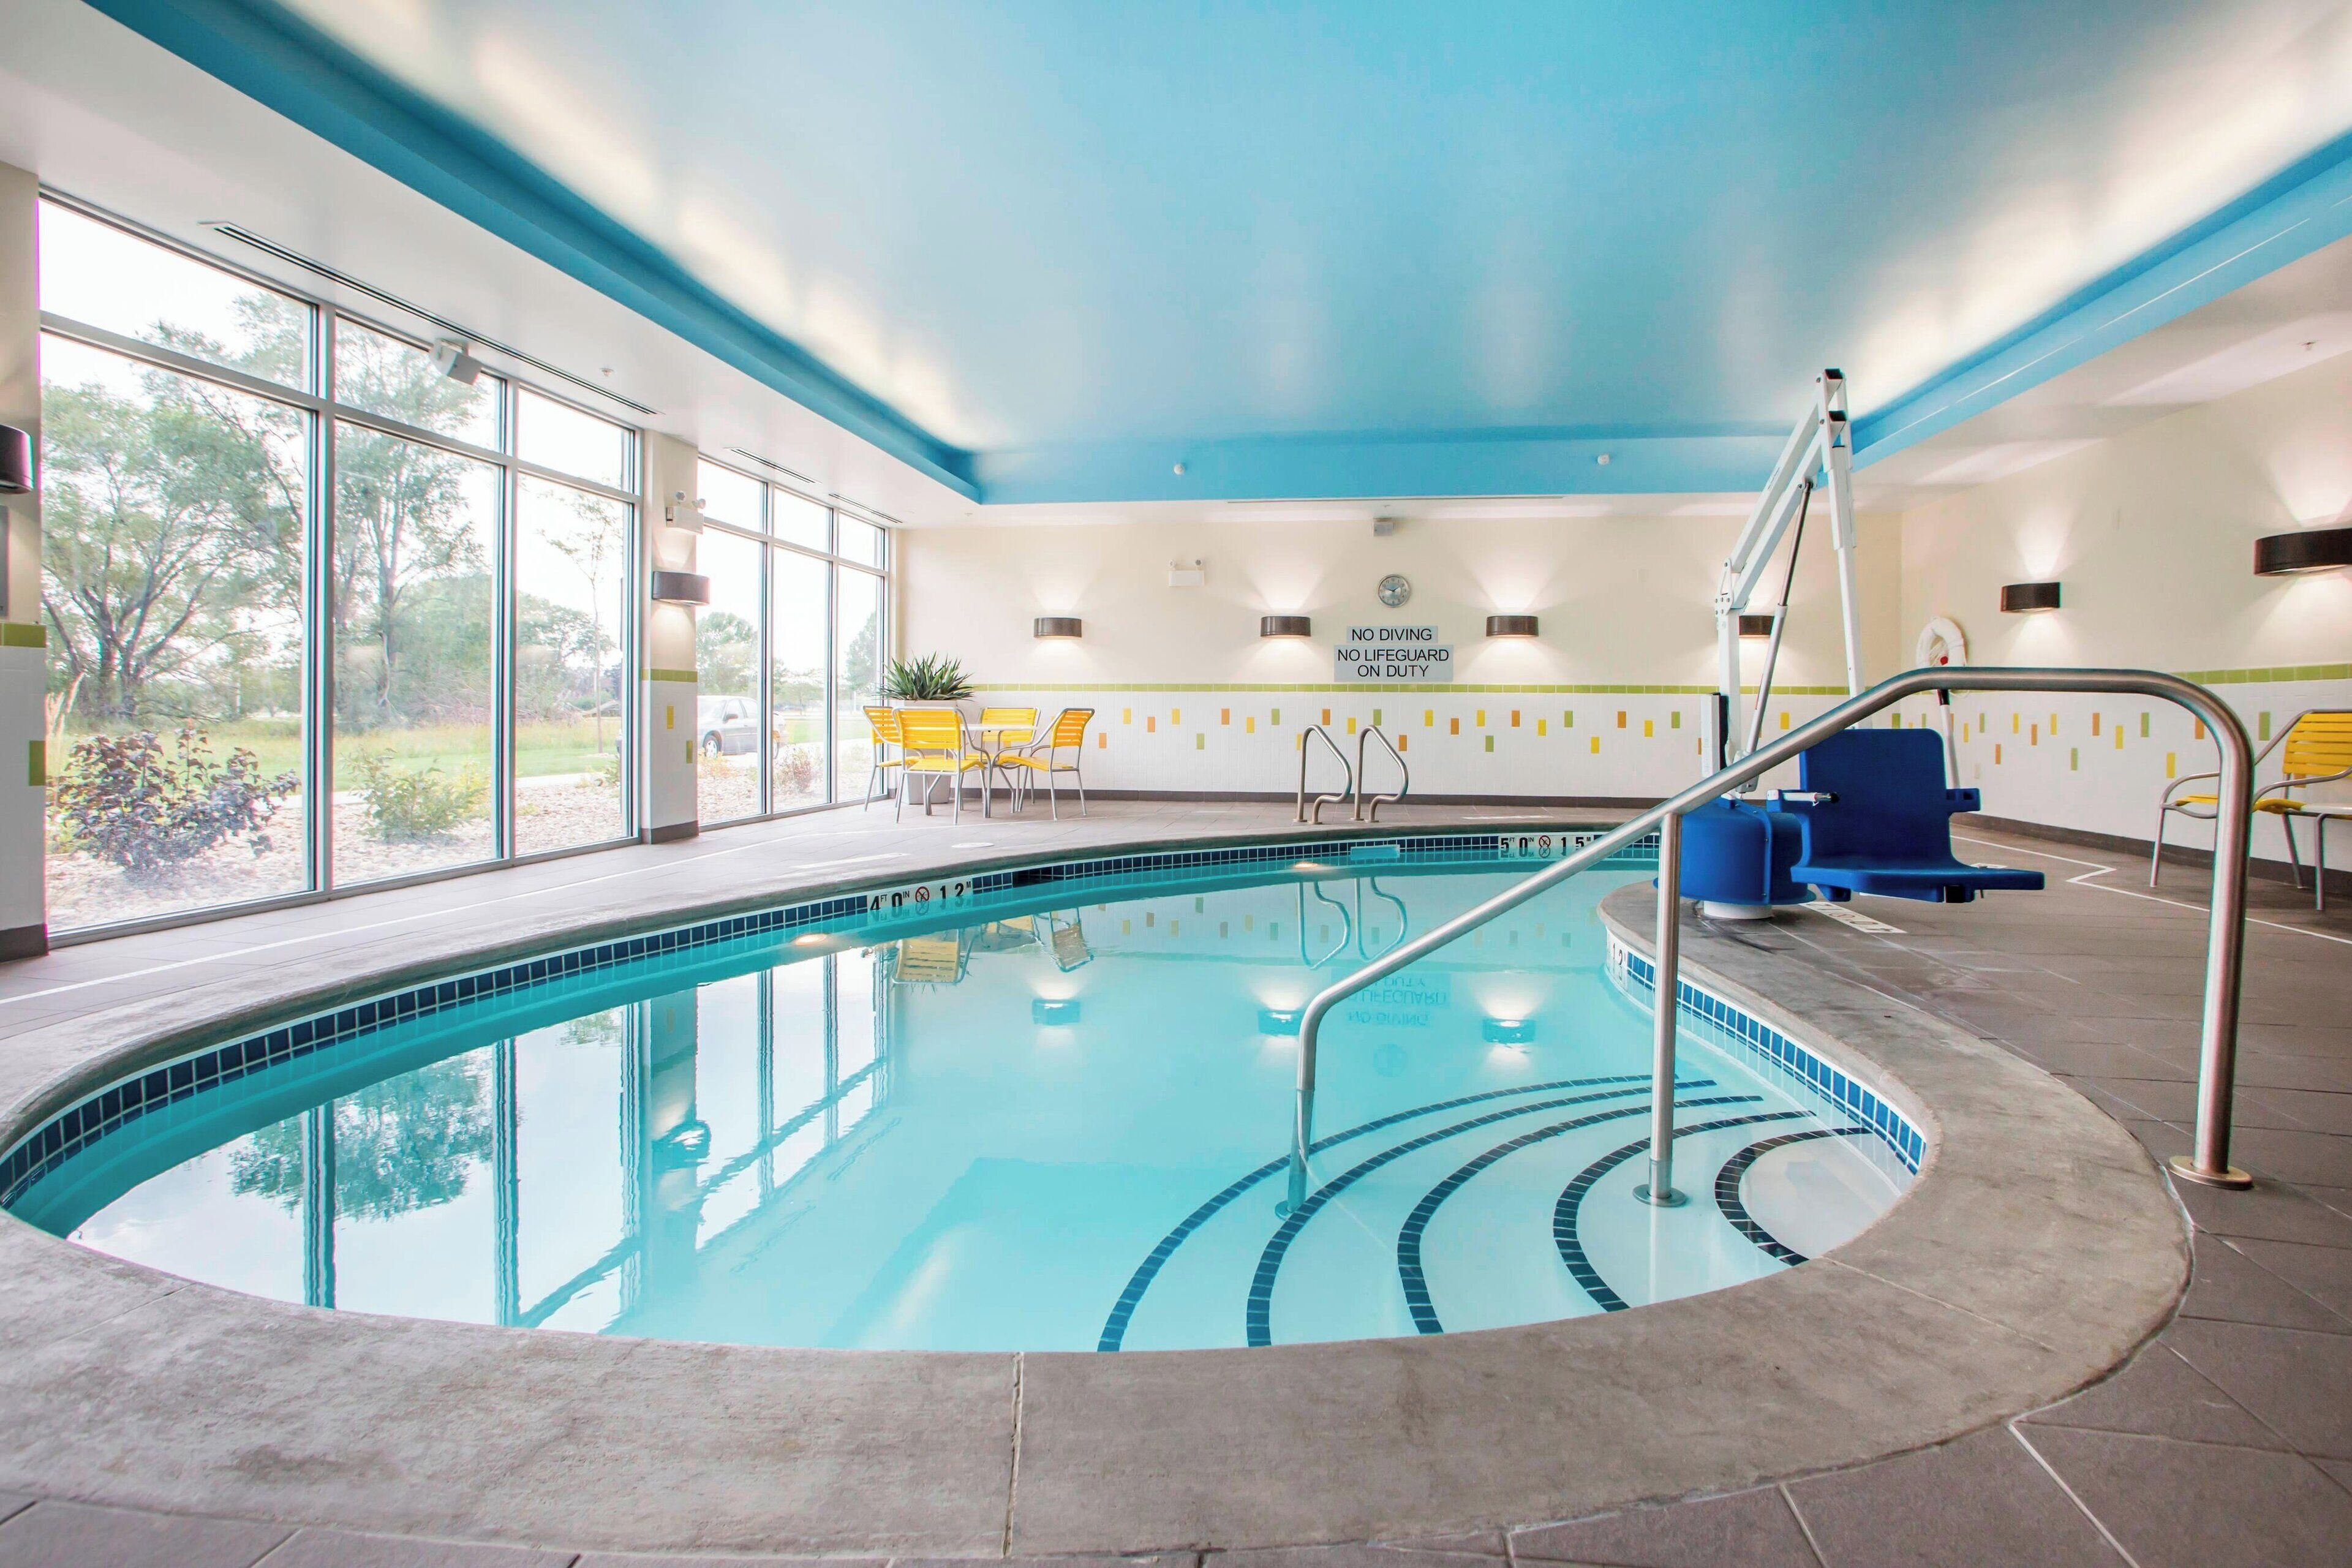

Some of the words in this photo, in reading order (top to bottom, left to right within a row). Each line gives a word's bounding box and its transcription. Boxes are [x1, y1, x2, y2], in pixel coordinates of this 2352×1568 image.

[1352, 628, 1374, 641] NO
[1380, 628, 1432, 641] DIVING
[1338, 649, 1360, 662] NO
[1365, 649, 1449, 662] LIFEGUARD
[1357, 665, 1380, 677] ON
[1387, 665, 1429, 677] DUTY
